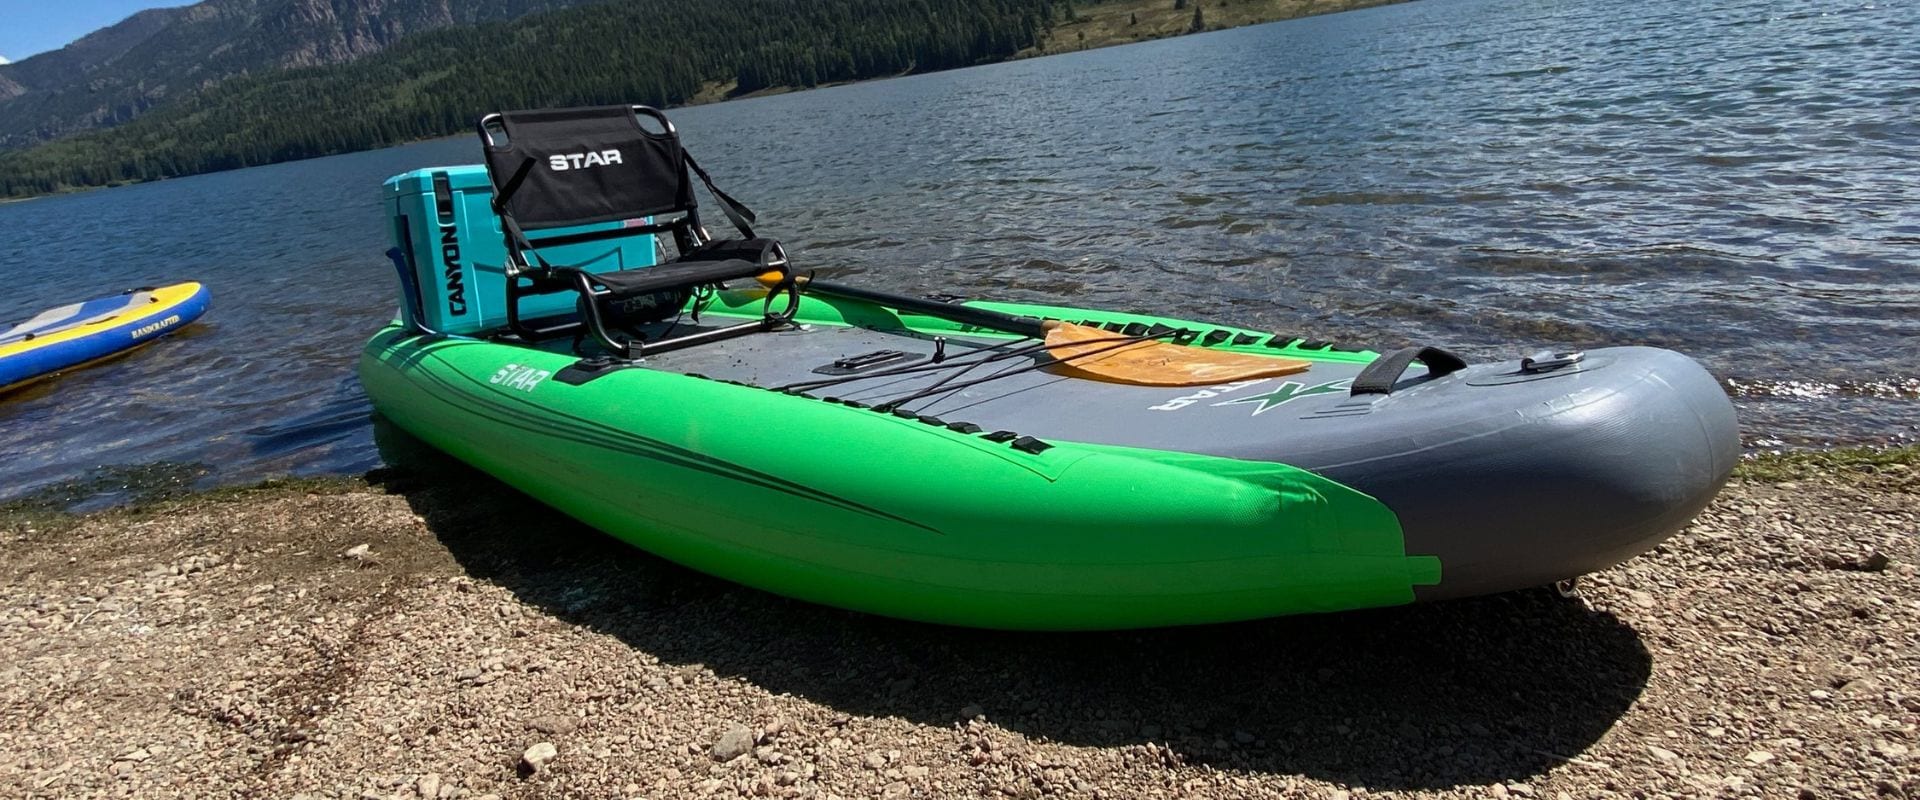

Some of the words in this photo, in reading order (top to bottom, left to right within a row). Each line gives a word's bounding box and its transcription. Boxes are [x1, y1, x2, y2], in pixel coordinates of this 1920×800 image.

[549, 149, 623, 171] STAR
[440, 225, 467, 316] CANYON
[131, 314, 180, 339] HANDCRAFTED
[489, 363, 551, 393] STAR
